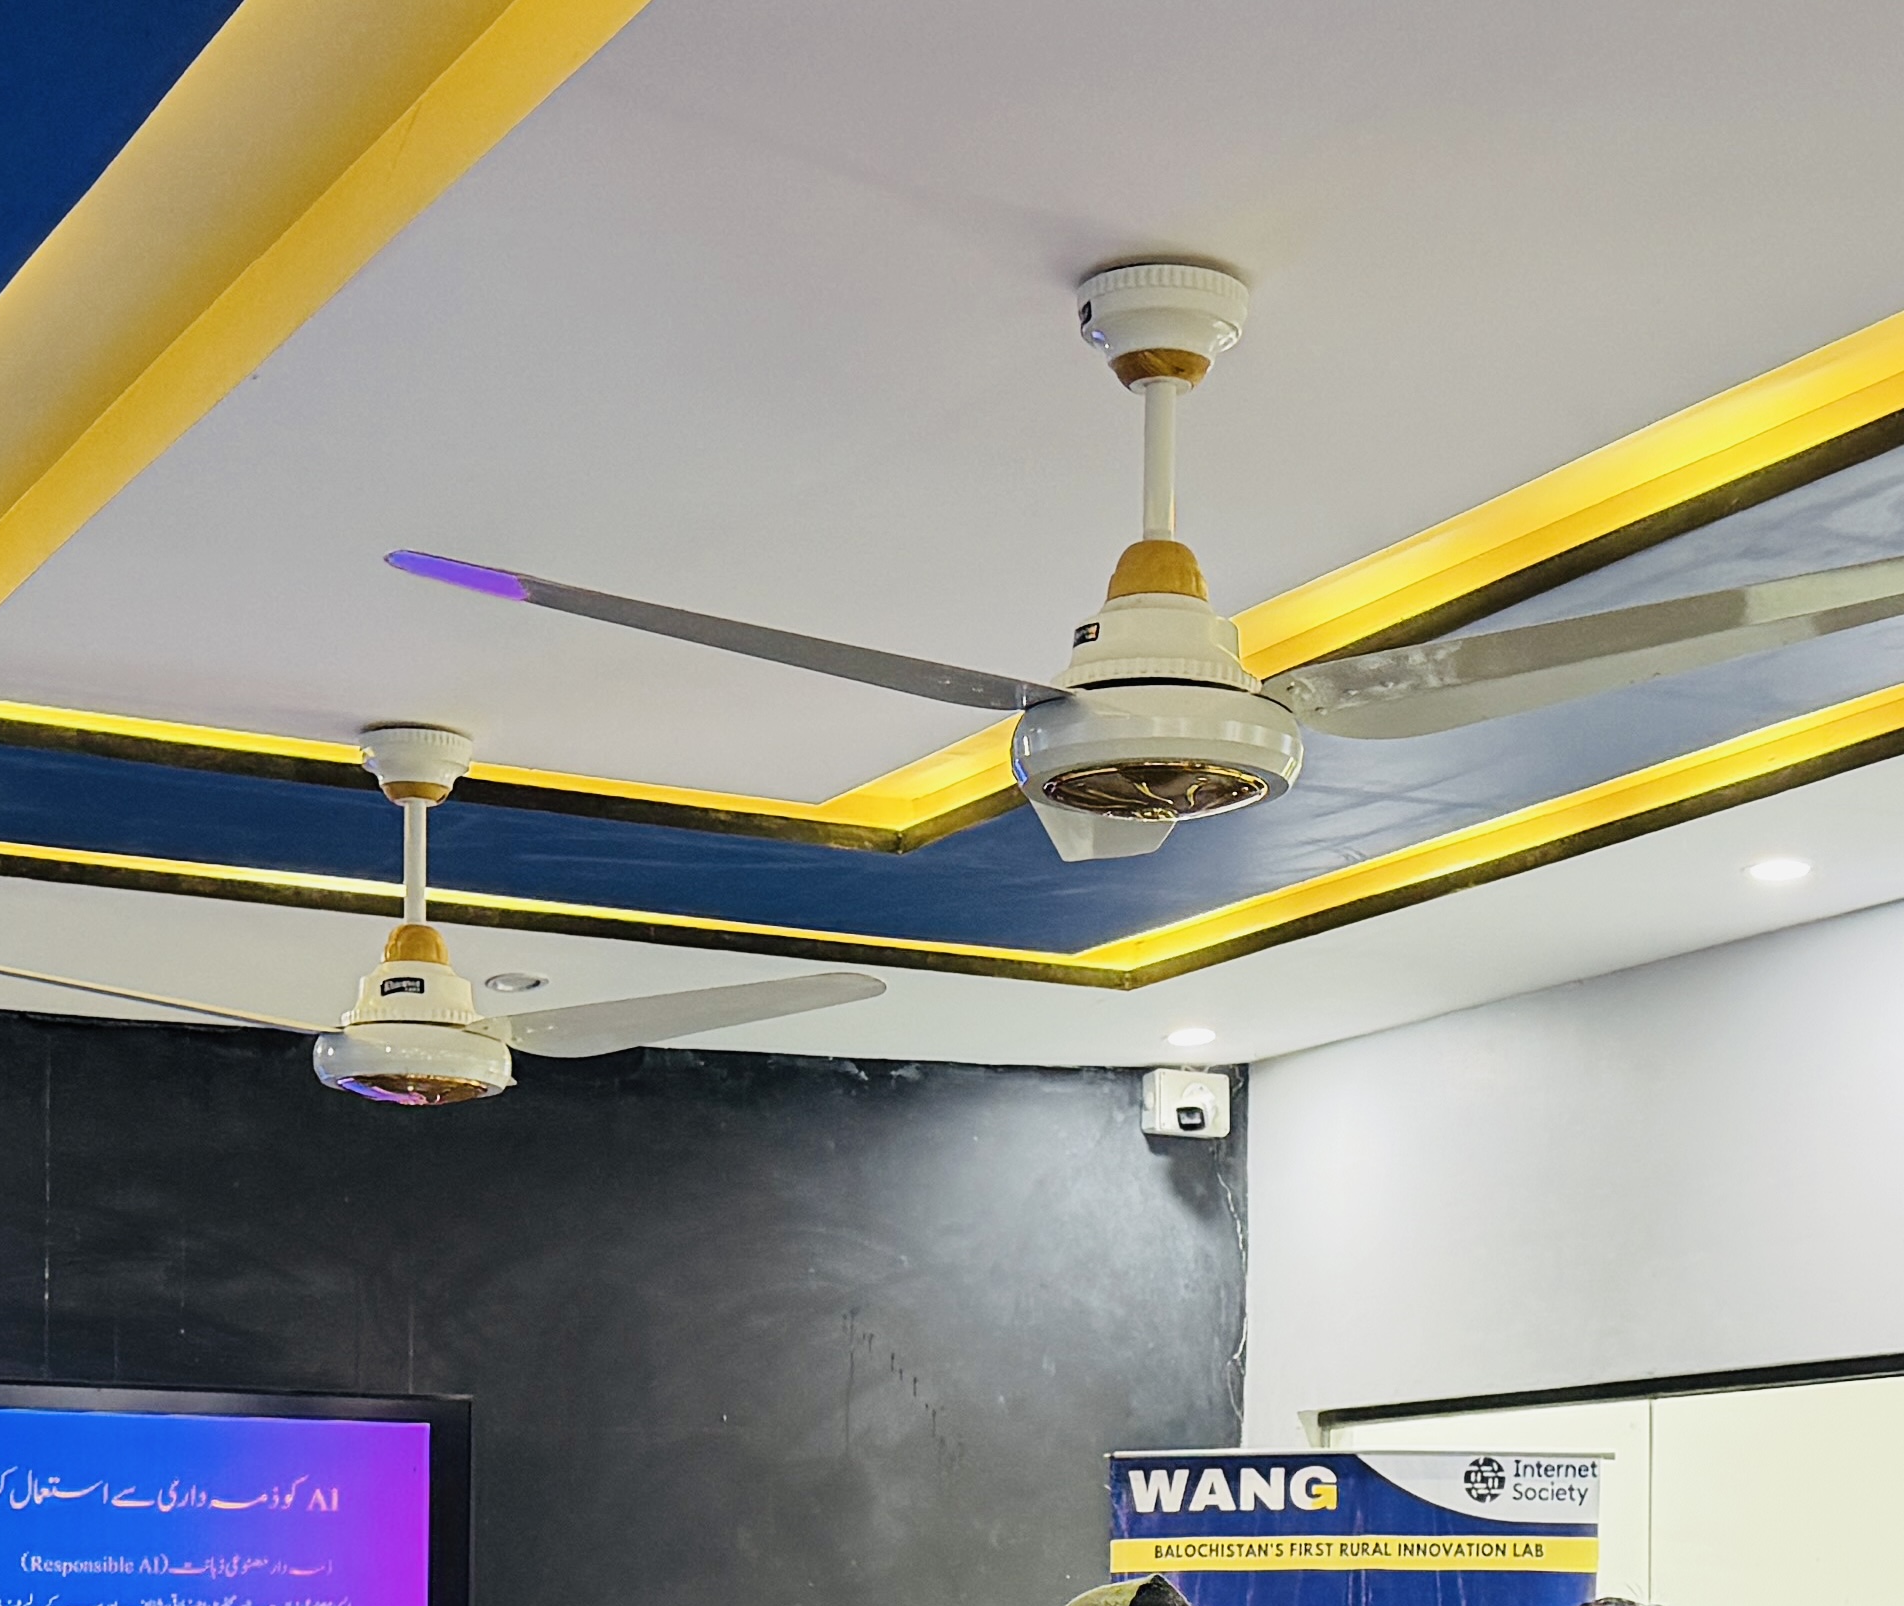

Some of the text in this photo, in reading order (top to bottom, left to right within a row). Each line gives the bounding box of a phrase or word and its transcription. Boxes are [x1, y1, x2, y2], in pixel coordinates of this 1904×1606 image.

[1514, 1459, 1598, 1478] Internet
[111, 1486, 155, 1508] سے
[281, 1474, 310, 1510] کو
[306, 1487, 339, 1511] AI
[1128, 1466, 1338, 1513] WANG
[1512, 1481, 1589, 1506] Society
[1154, 1542, 1544, 1559] BALOCHISTAN'S FIRST RURAL INNOVATION LAB
